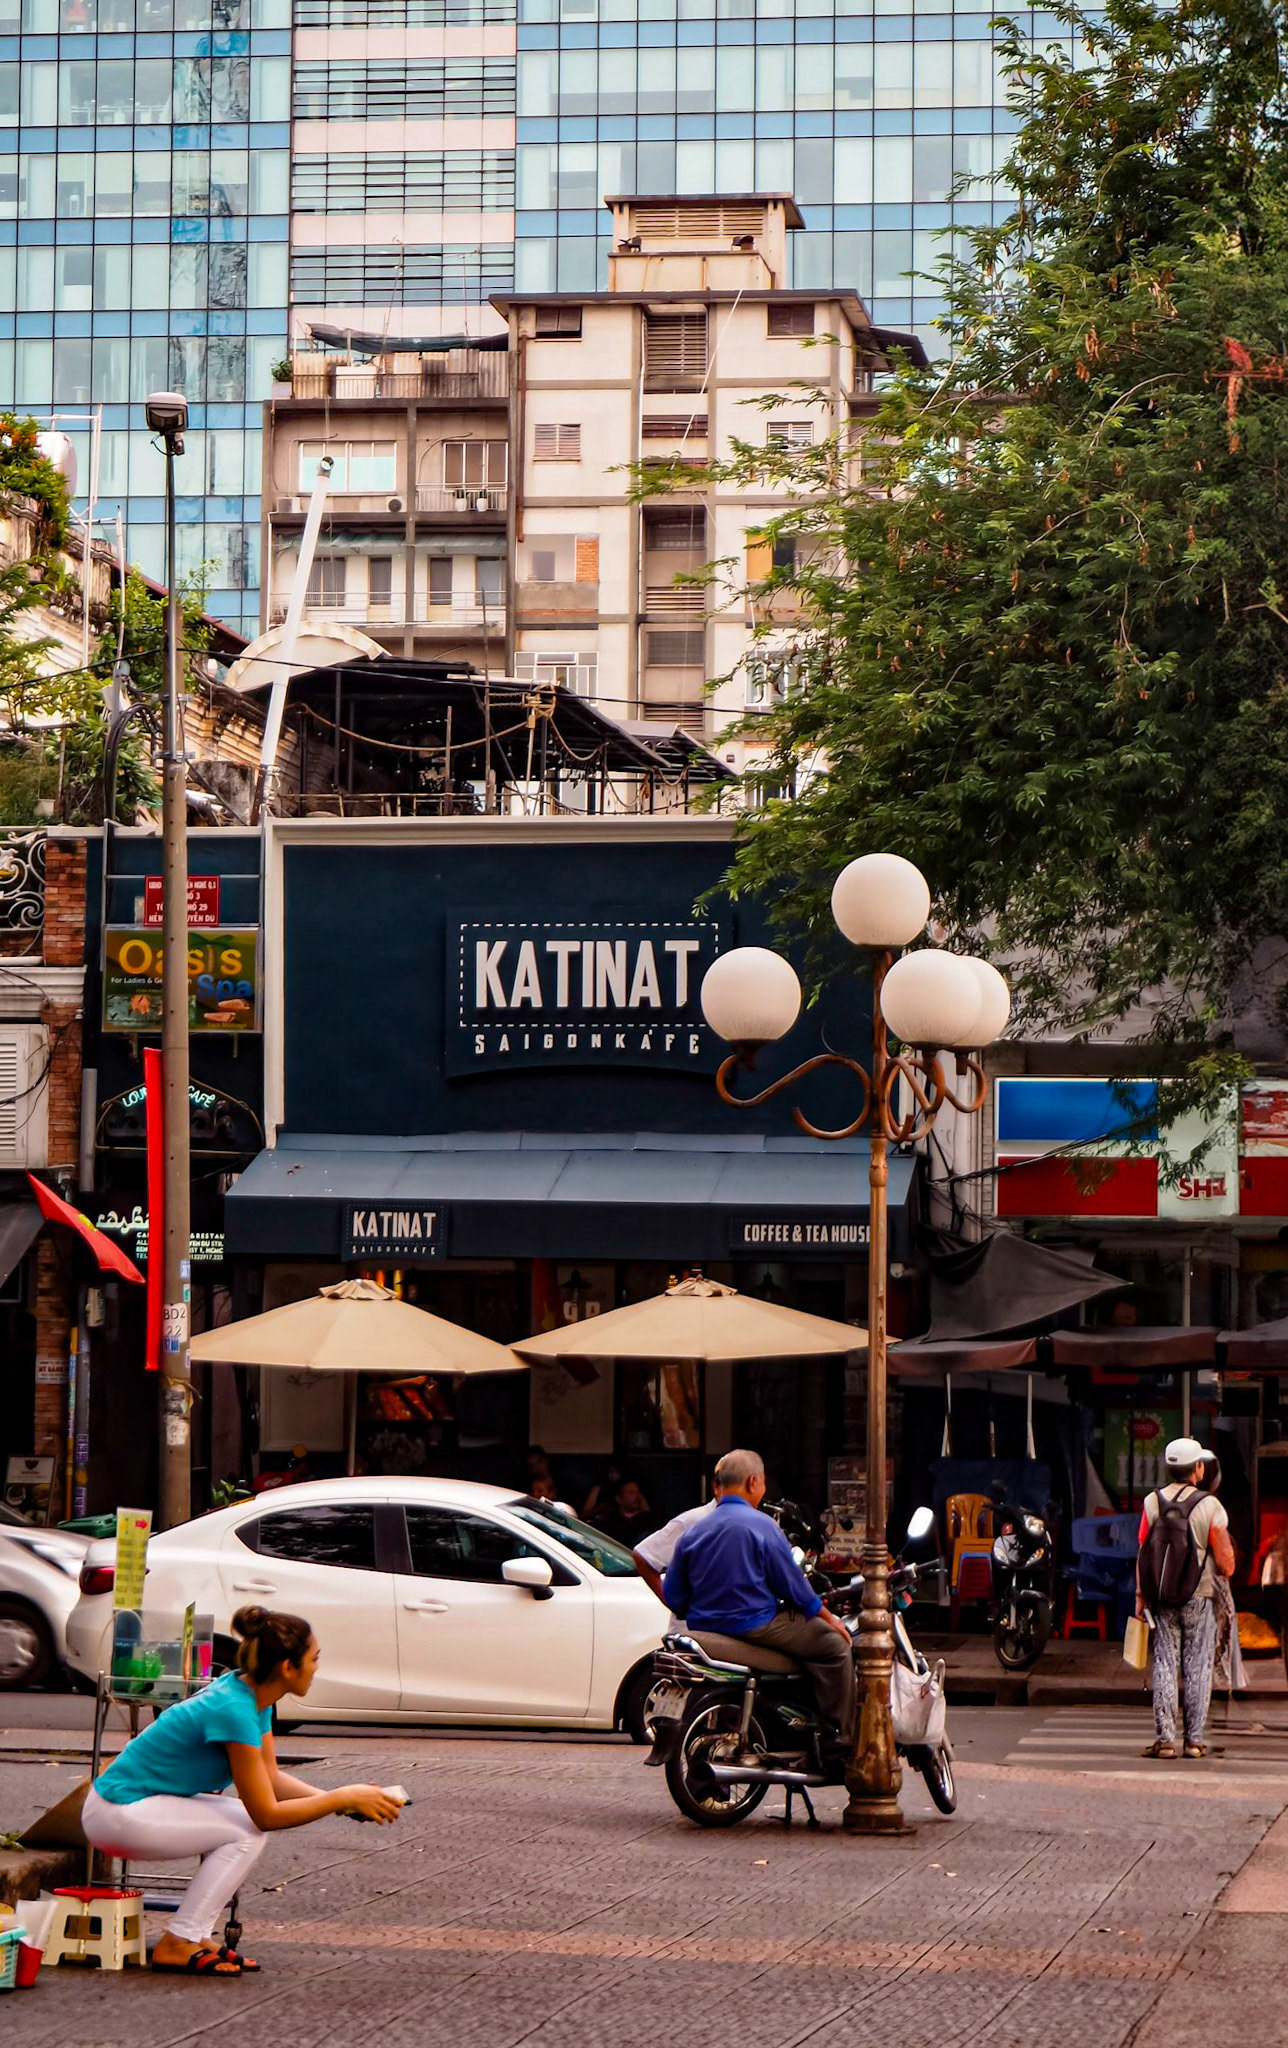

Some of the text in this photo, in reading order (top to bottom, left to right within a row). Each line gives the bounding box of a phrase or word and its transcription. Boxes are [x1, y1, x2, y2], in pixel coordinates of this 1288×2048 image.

[197, 973, 252, 1003] Spa
[475, 940, 700, 1008] KATINAT
[352, 1211, 437, 1238] KATINAT
[744, 1224, 789, 1242] COFFEE
[792, 1224, 802, 1242] &
[806, 1225, 828, 1242] TEA
